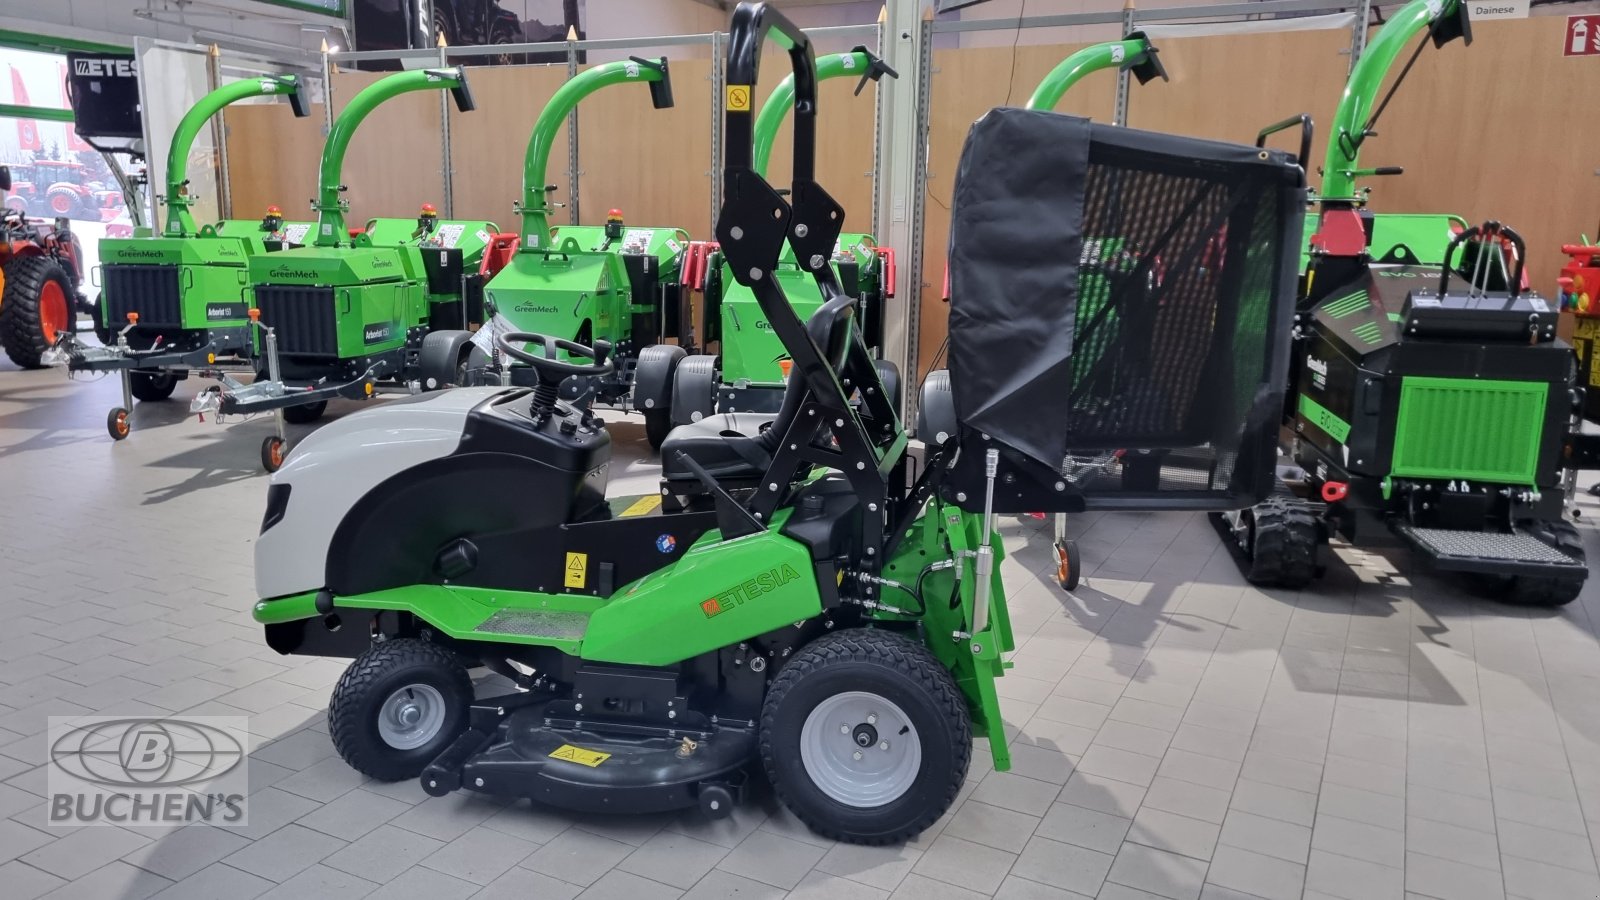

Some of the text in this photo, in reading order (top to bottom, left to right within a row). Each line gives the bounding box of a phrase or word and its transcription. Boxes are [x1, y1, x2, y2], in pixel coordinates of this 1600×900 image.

[1476, 6, 1515, 15] Dainese
[118, 249, 164, 258] GreenMech
[269, 269, 319, 279] GreenMech
[1379, 271, 1417, 279] EVO
[208, 307, 225, 317] Arborist
[514, 305, 559, 313] GreenMech
[365, 329, 383, 341] Arborist
[716, 563, 801, 614] ETESIA
